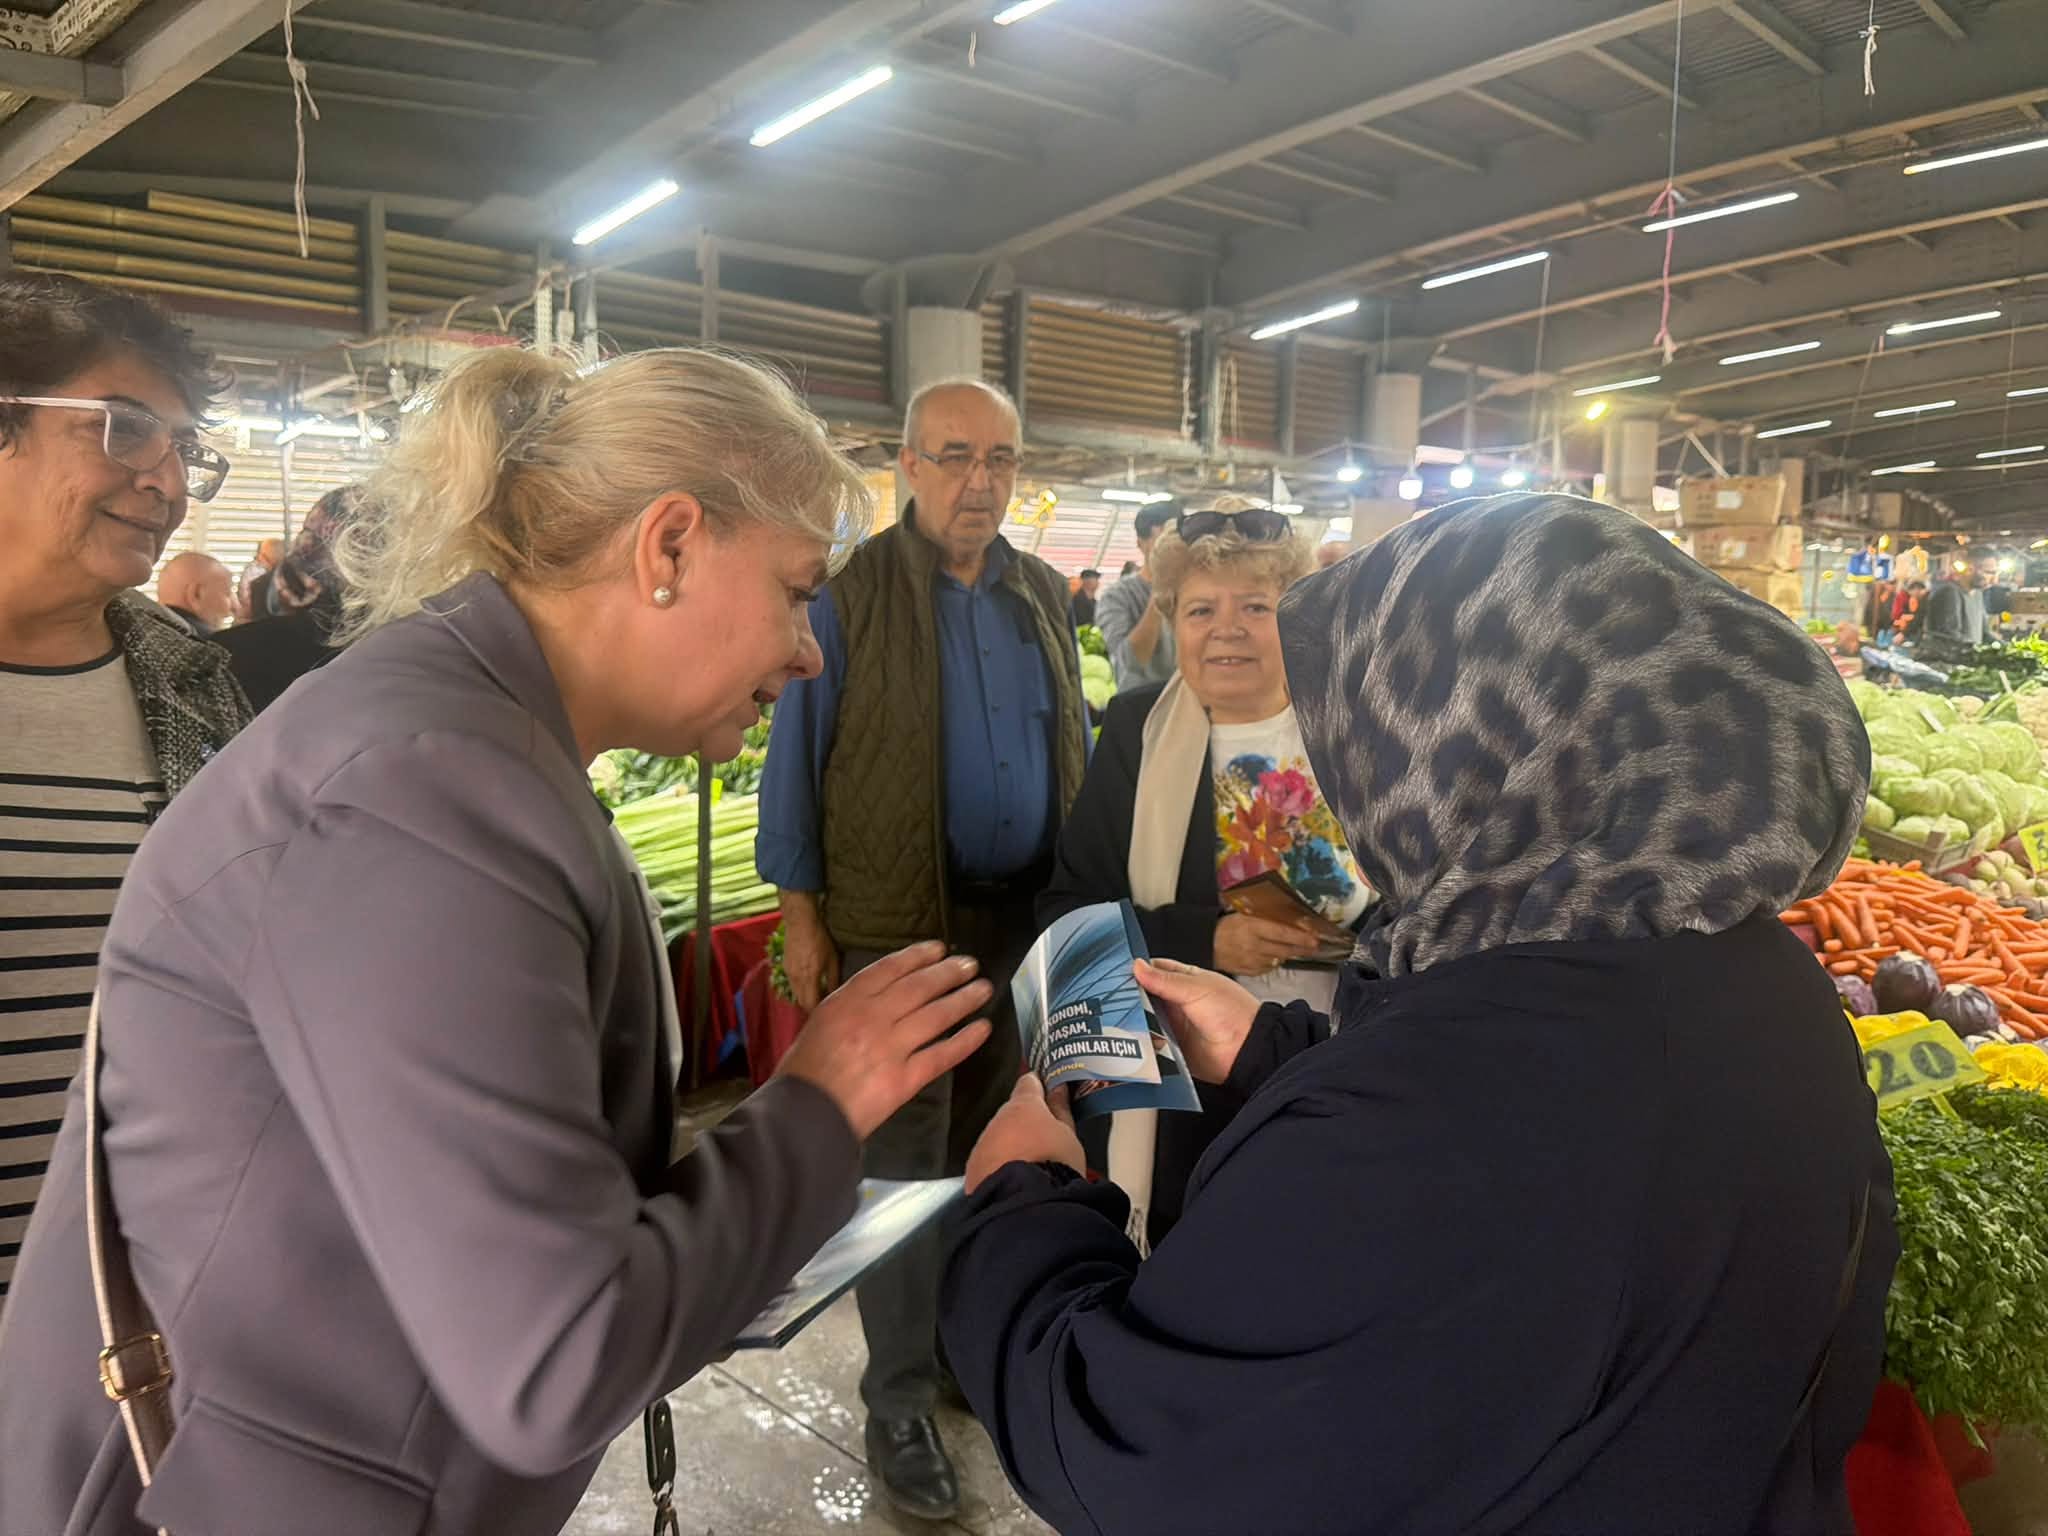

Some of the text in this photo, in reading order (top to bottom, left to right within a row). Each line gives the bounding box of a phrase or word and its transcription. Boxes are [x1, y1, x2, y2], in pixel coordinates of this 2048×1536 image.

[1047, 1001, 1092, 1028] KONOMİ,
[1049, 1021, 1091, 1043] YAŞAM,
[1051, 1039, 1137, 1061] YARINLAR İÇİN
[1863, 1041, 1956, 1097] 20
